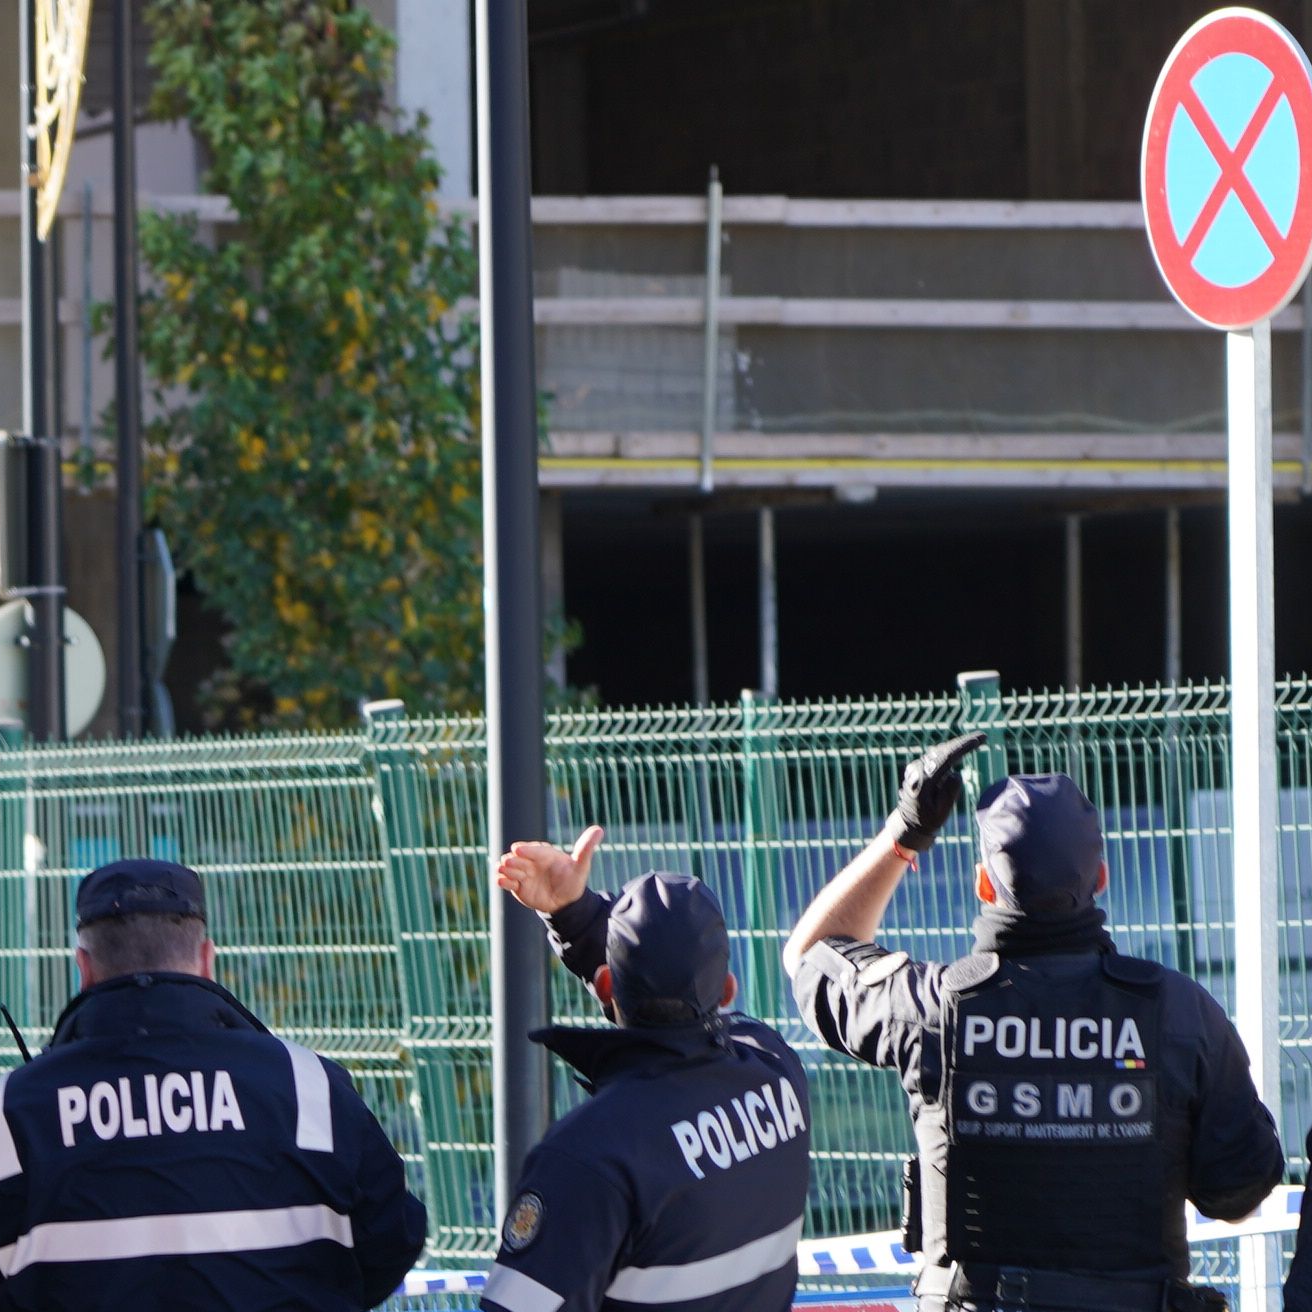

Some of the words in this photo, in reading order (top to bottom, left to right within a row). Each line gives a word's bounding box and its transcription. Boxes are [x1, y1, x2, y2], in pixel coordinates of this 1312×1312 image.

[964, 1015, 1145, 1059] POLICIA
[57, 1070, 244, 1147] POLICIA
[670, 1076, 806, 1179] POLICIA
